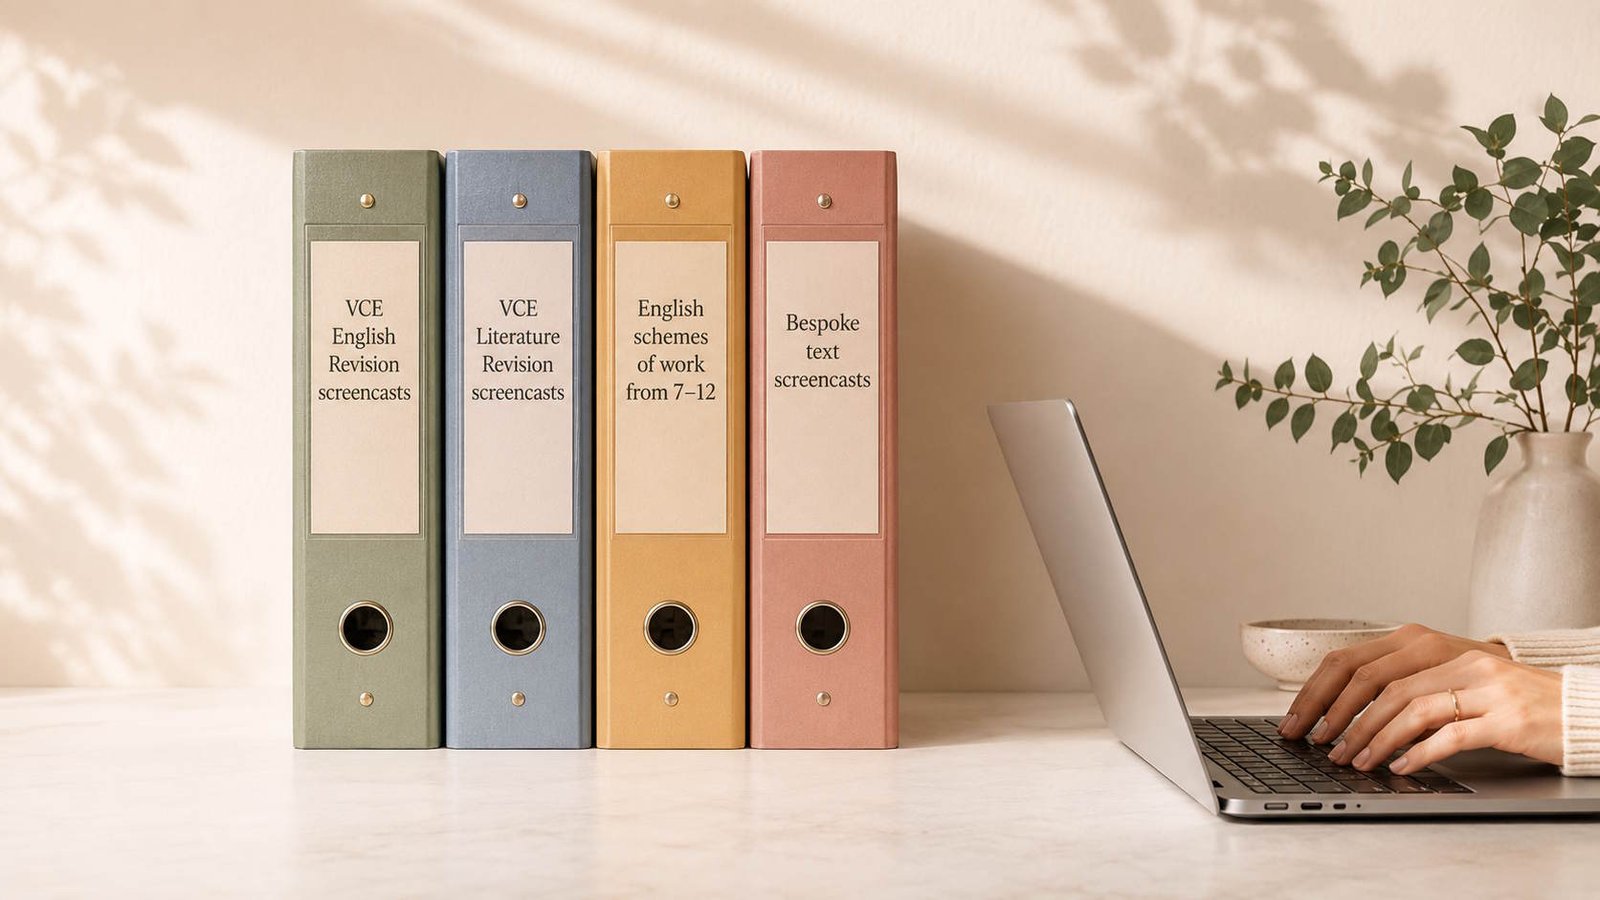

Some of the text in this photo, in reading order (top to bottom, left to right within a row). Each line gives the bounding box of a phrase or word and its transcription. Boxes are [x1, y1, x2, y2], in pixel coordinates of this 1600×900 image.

[345, 299, 384, 316] VCE
[499, 298, 538, 317] VCE
[638, 298, 704, 321] English
[786, 312, 860, 336] Bespoke
[332, 326, 397, 349] English
[476, 326, 561, 345] Literature
[633, 326, 709, 345] schemes
[805, 344, 840, 360] text
[328, 354, 400, 373] Revision
[482, 354, 554, 373] Revision
[637, 353, 706, 373] of work
[774, 371, 871, 388] screencasts
[318, 384, 412, 401] screencasts
[471, 384, 565, 401] screencasts
[625, 382, 669, 401] from
